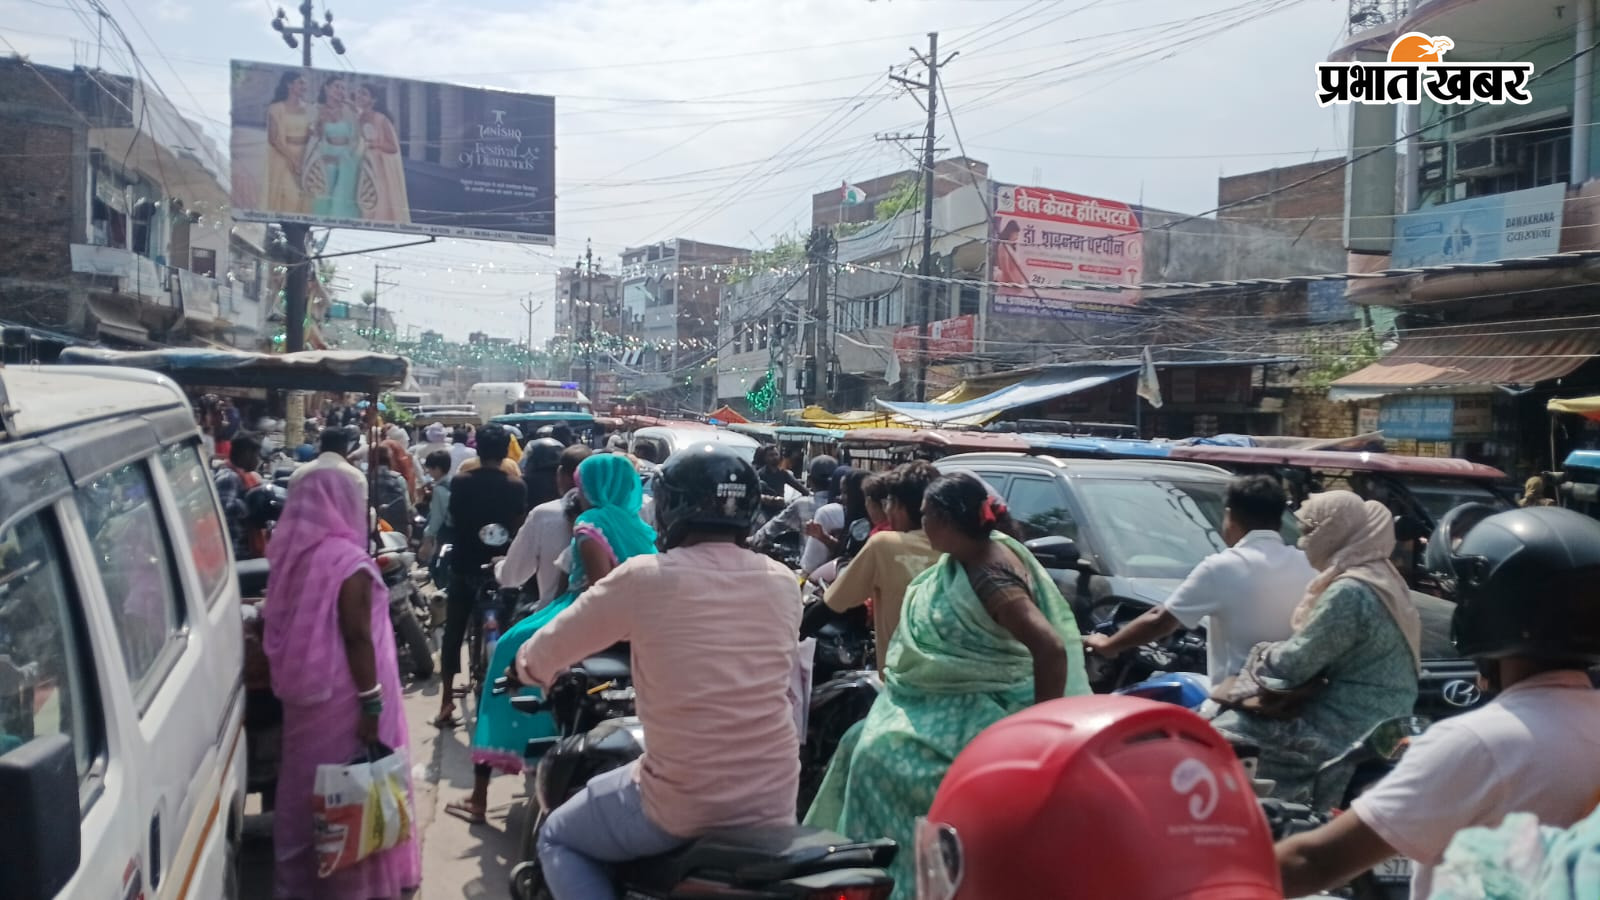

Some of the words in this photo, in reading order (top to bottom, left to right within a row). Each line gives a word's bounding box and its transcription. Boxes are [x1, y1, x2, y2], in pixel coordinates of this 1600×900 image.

[475, 142, 519, 158] Festival
[458, 152, 474, 168] Of
[476, 152, 536, 170] Diamonds
[1016, 189, 1041, 214] वेल
[1043, 192, 1074, 218] केयर
[1076, 200, 1131, 226] हॉस्पिटल
[1505, 211, 1555, 229] DAWAKHANA
[1088, 234, 1125, 256] परवीन
